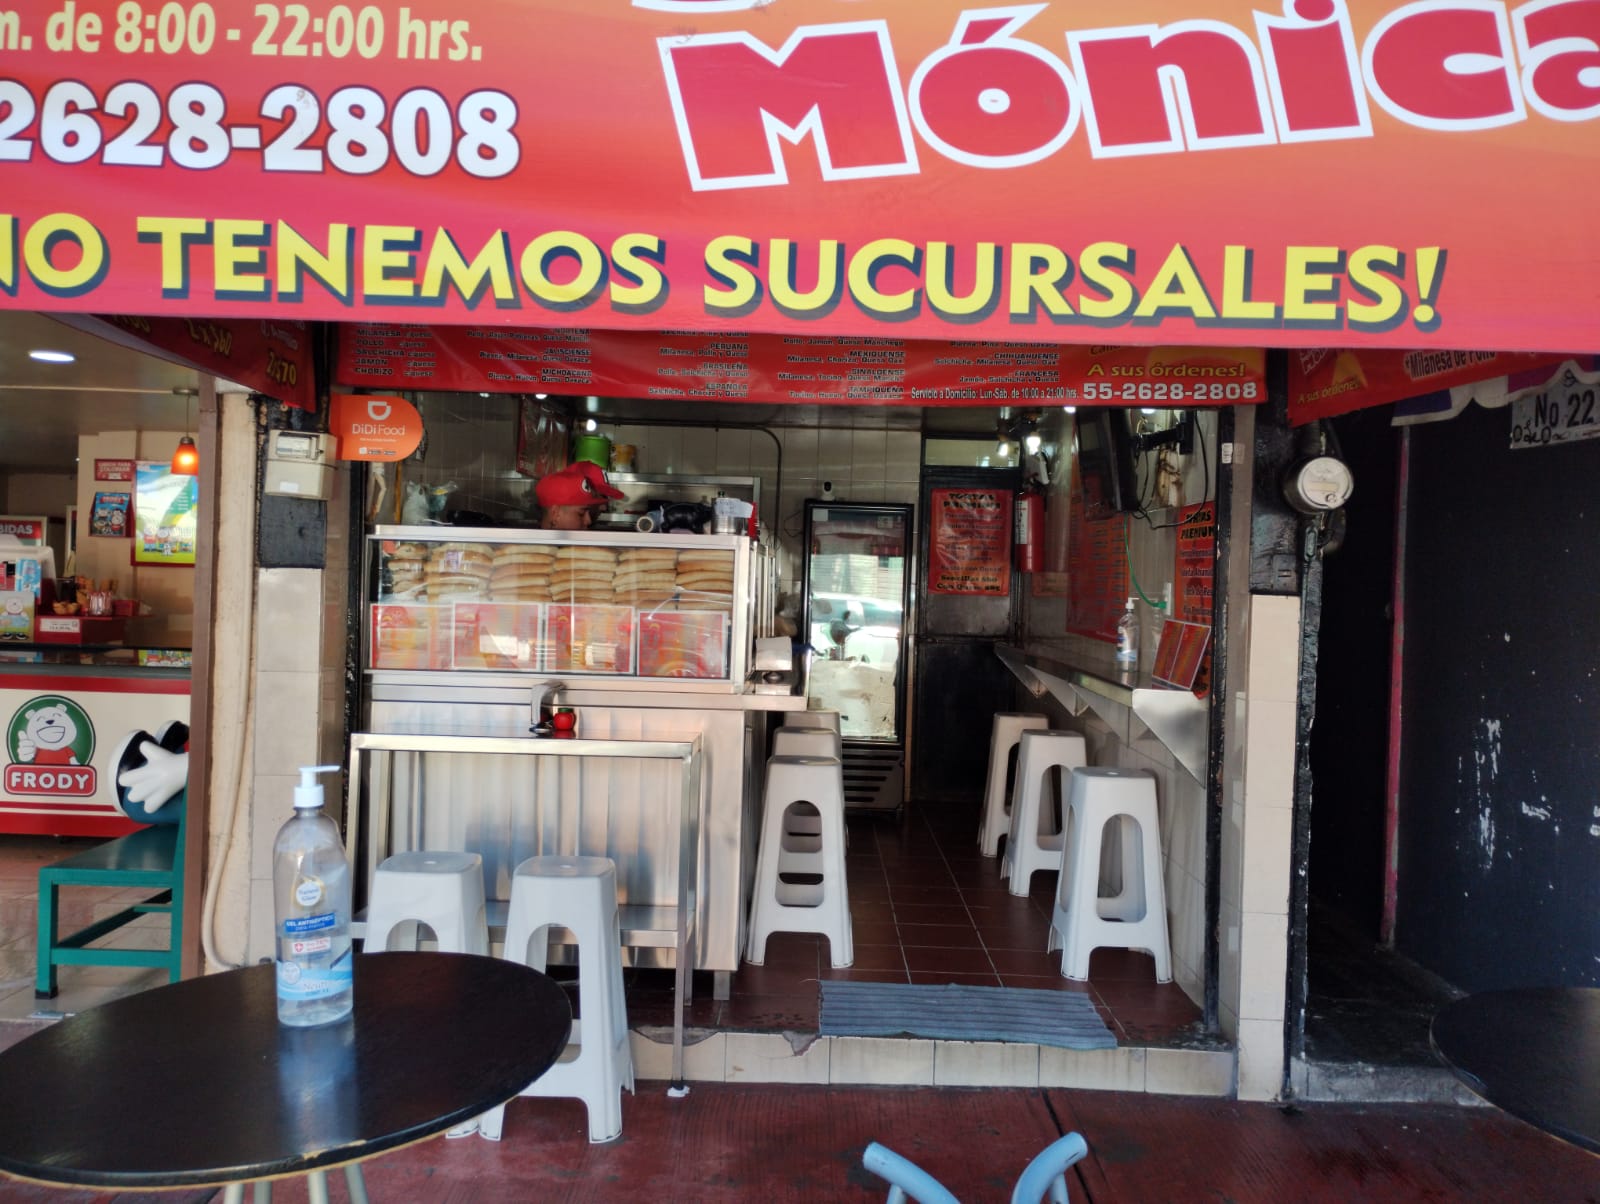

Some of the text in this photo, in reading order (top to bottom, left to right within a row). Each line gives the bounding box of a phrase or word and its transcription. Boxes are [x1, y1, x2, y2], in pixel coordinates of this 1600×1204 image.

[46, 0, 103, 53] de
[114, 1, 216, 56] 8:00
[251, 6, 385, 58] 22:00
[398, 13, 483, 61] hrs.
[655, 0, 1600, 193] Mónica
[0, 78, 521, 178] 2628-2808
[0, 212, 1448, 333] O TENEMOS SUCURSALES!
[356, 338, 384, 346] POLLO
[355, 348, 405, 357] SALCHICHA
[544, 348, 591, 356] JALISCIENSE
[849, 350, 905, 358] MEXIQUENSE
[994, 352, 1060, 360] CHIHUAHUENSE
[703, 361, 748, 370] BRASILEÑA
[1087, 362, 1246, 377] A sus órdenes!
[354, 367, 393, 376] CHORIZO
[541, 368, 592, 377] MICHOACANA
[850, 368, 905, 376] SINALOENSE
[706, 382, 748, 390] ESPAÑOLA
[849, 385, 904, 393] TAMPIQUEÑA
[911, 387, 938, 399] Servicio
[1011, 388, 1020, 399] de
[1021, 388, 1039, 399] 10:00
[1046, 387, 1065, 399] 21:00
[1066, 387, 1079, 400] hrs.
[1082, 382, 1258, 400] 55-2628-2808
[1534, 389, 1595, 429] No 22
[351, 423, 406, 436] DiDi Food
[11, 771, 90, 790] FRODY
